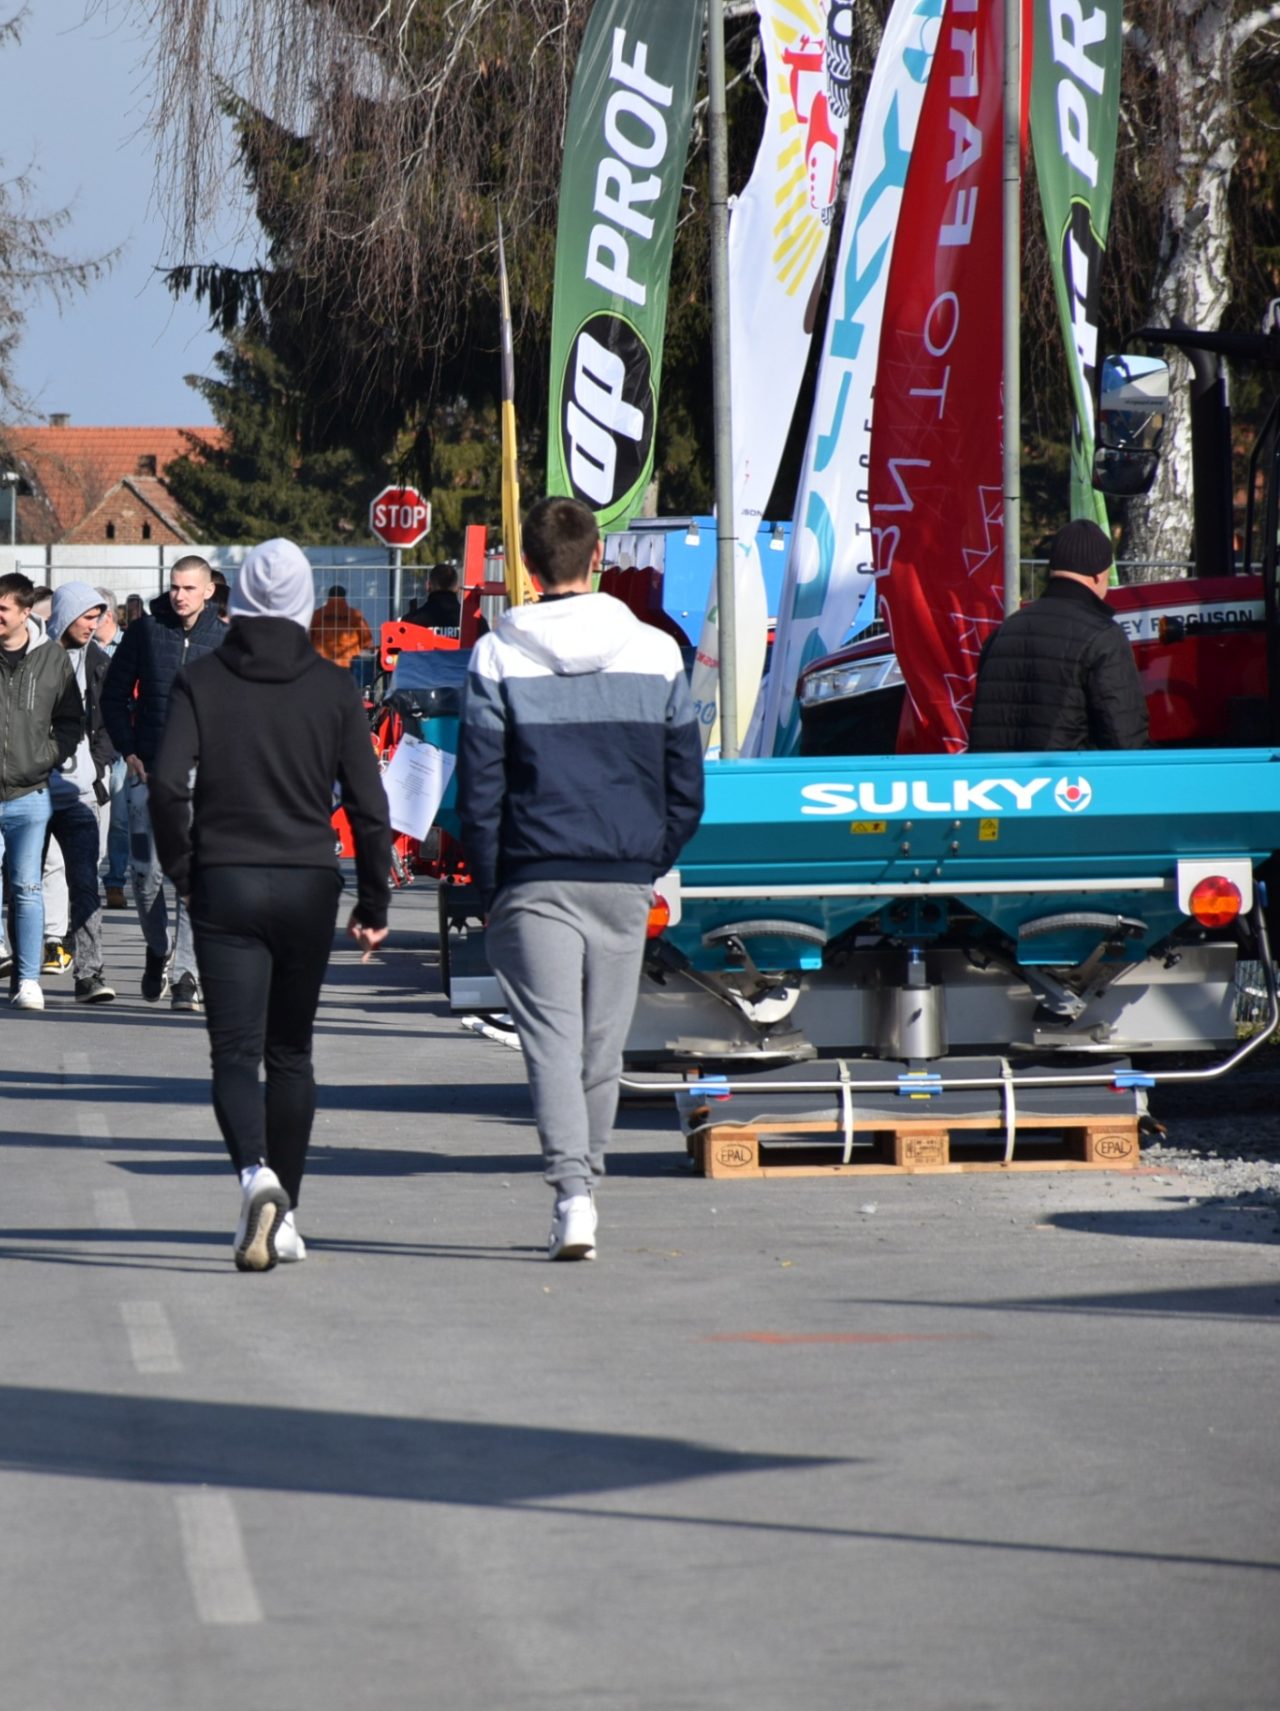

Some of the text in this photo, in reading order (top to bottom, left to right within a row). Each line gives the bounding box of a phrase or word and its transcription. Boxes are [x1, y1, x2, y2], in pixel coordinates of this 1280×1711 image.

[585, 27, 673, 306] PROF
[375, 505, 425, 528] STOP
[801, 777, 1053, 815] SULKY
[720, 1148, 747, 1162] EPAL
[1101, 1141, 1128, 1154] EPAL
